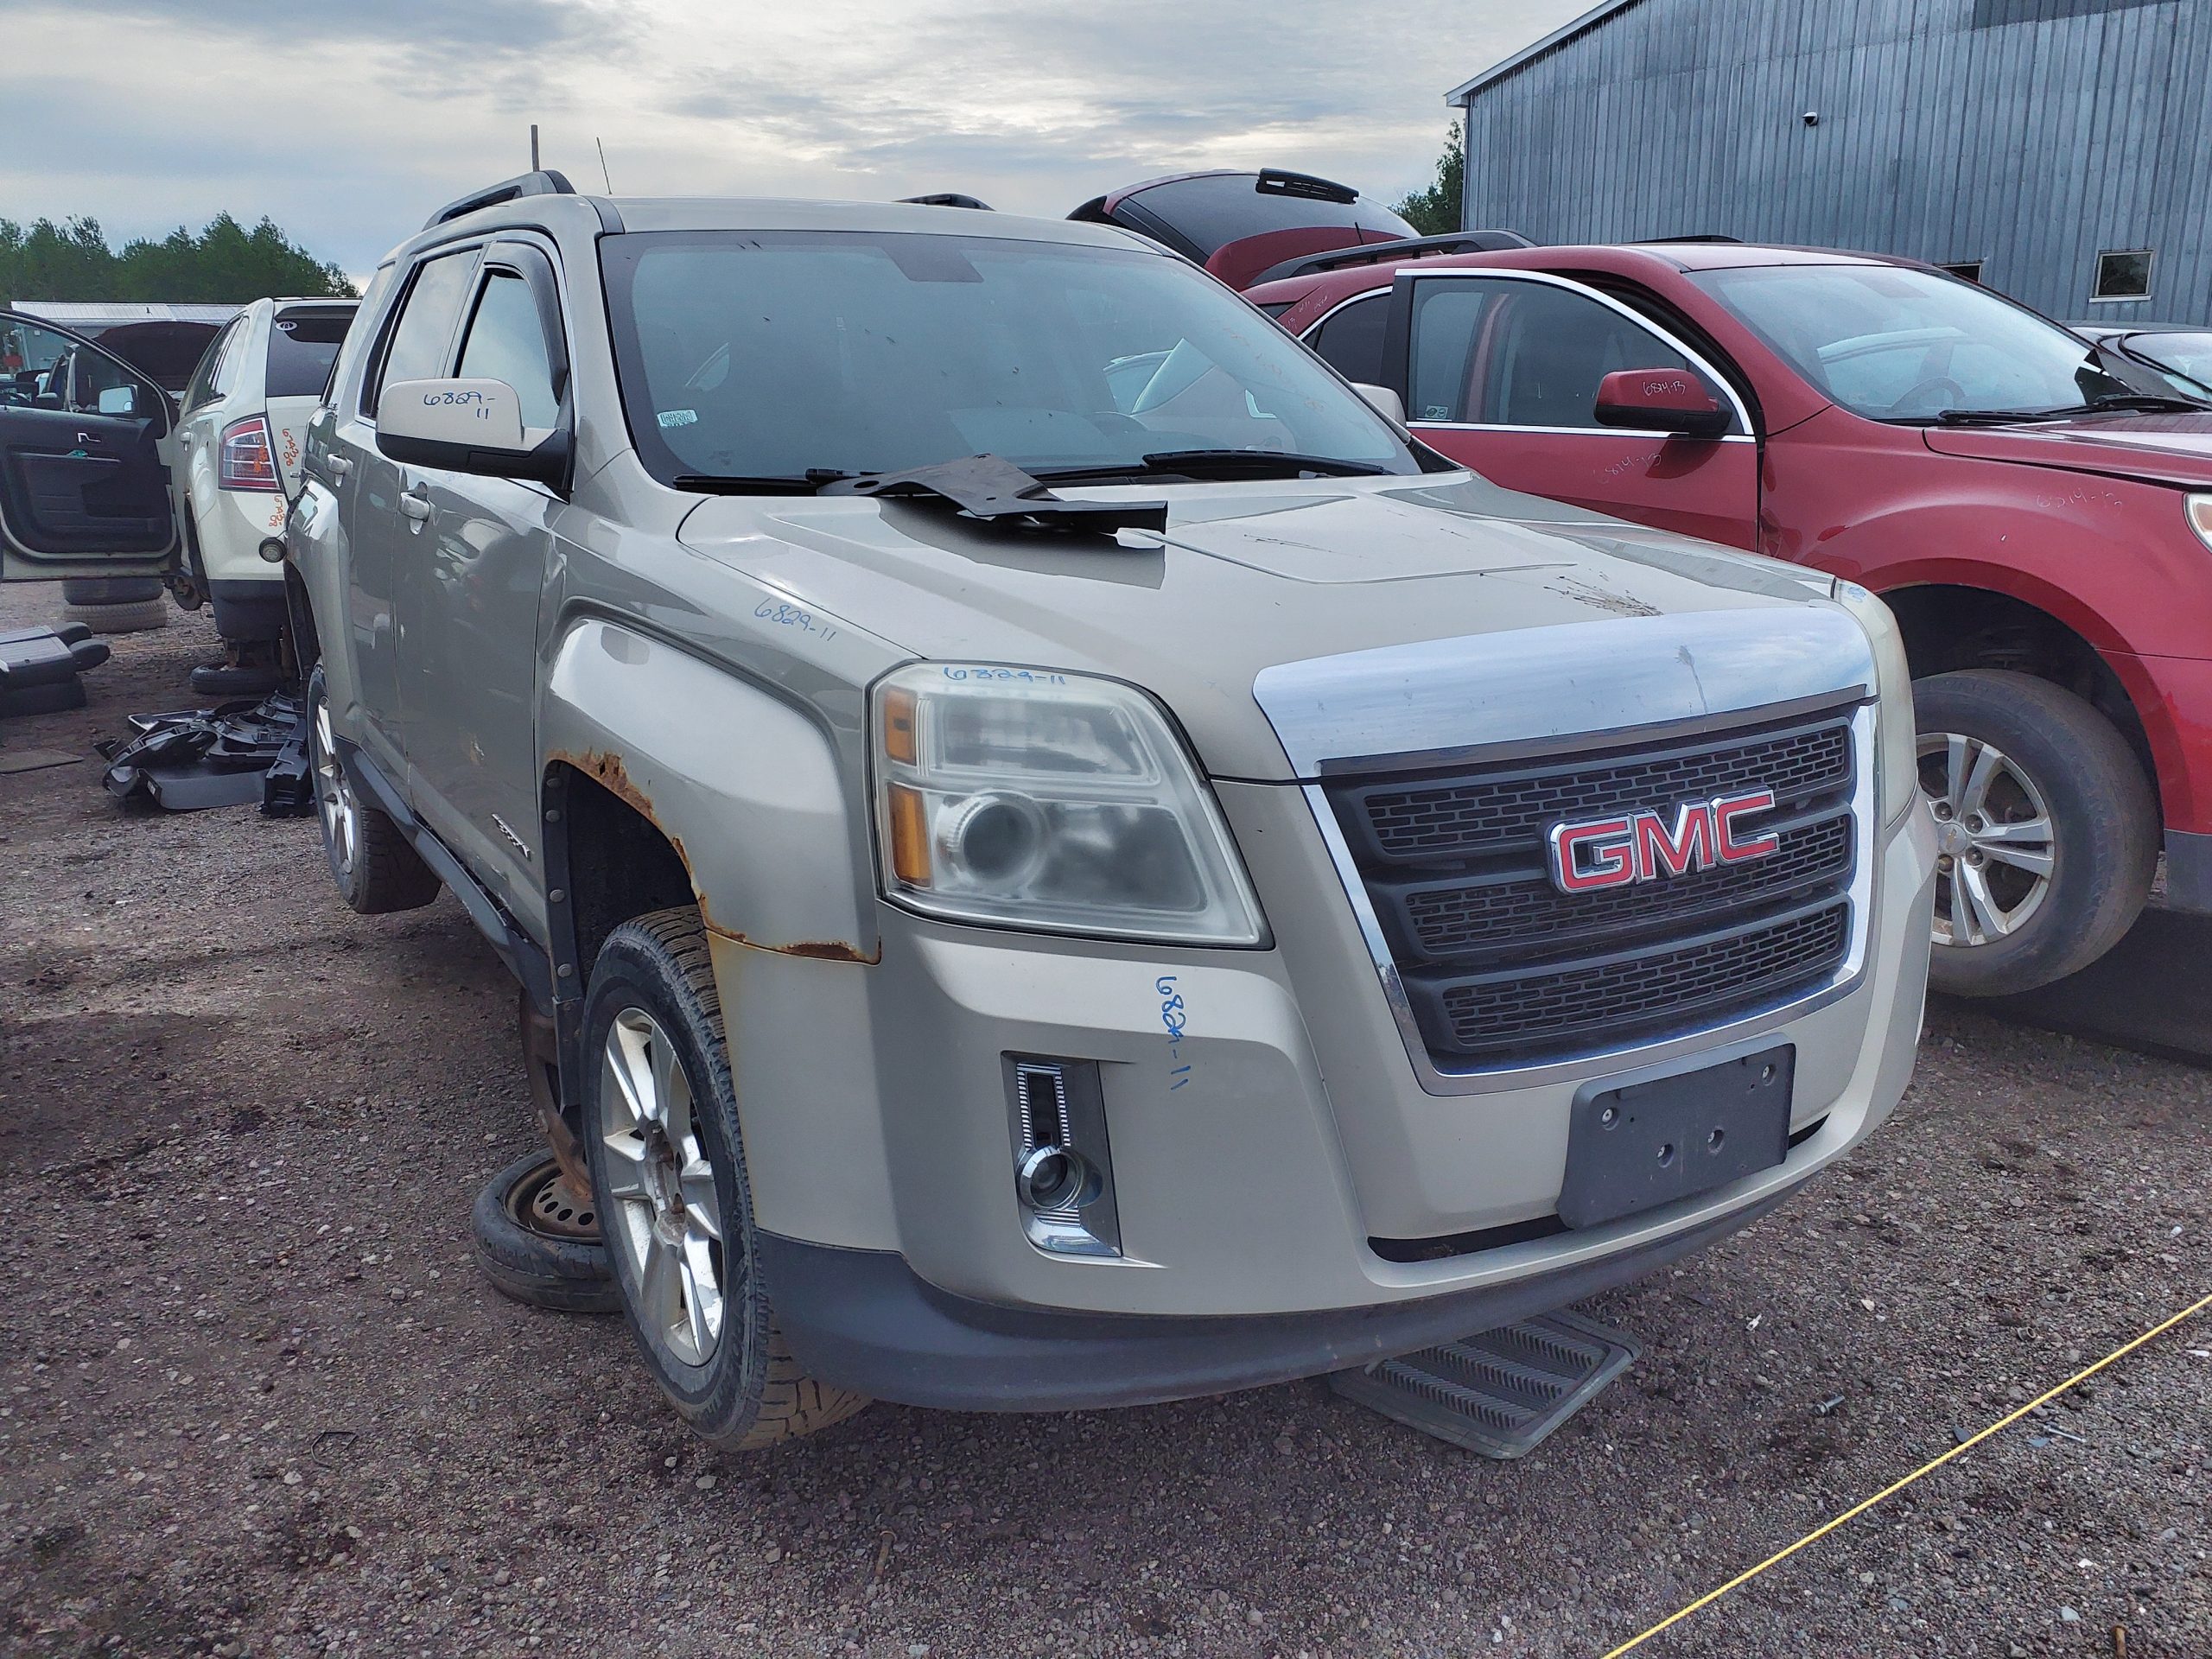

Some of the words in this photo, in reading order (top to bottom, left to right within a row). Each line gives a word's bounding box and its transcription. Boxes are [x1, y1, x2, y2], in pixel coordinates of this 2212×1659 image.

[754, 597, 836, 641] 6829-11
[944, 666, 1066, 685] 6829-11
[1547, 786, 1780, 893] GMC
